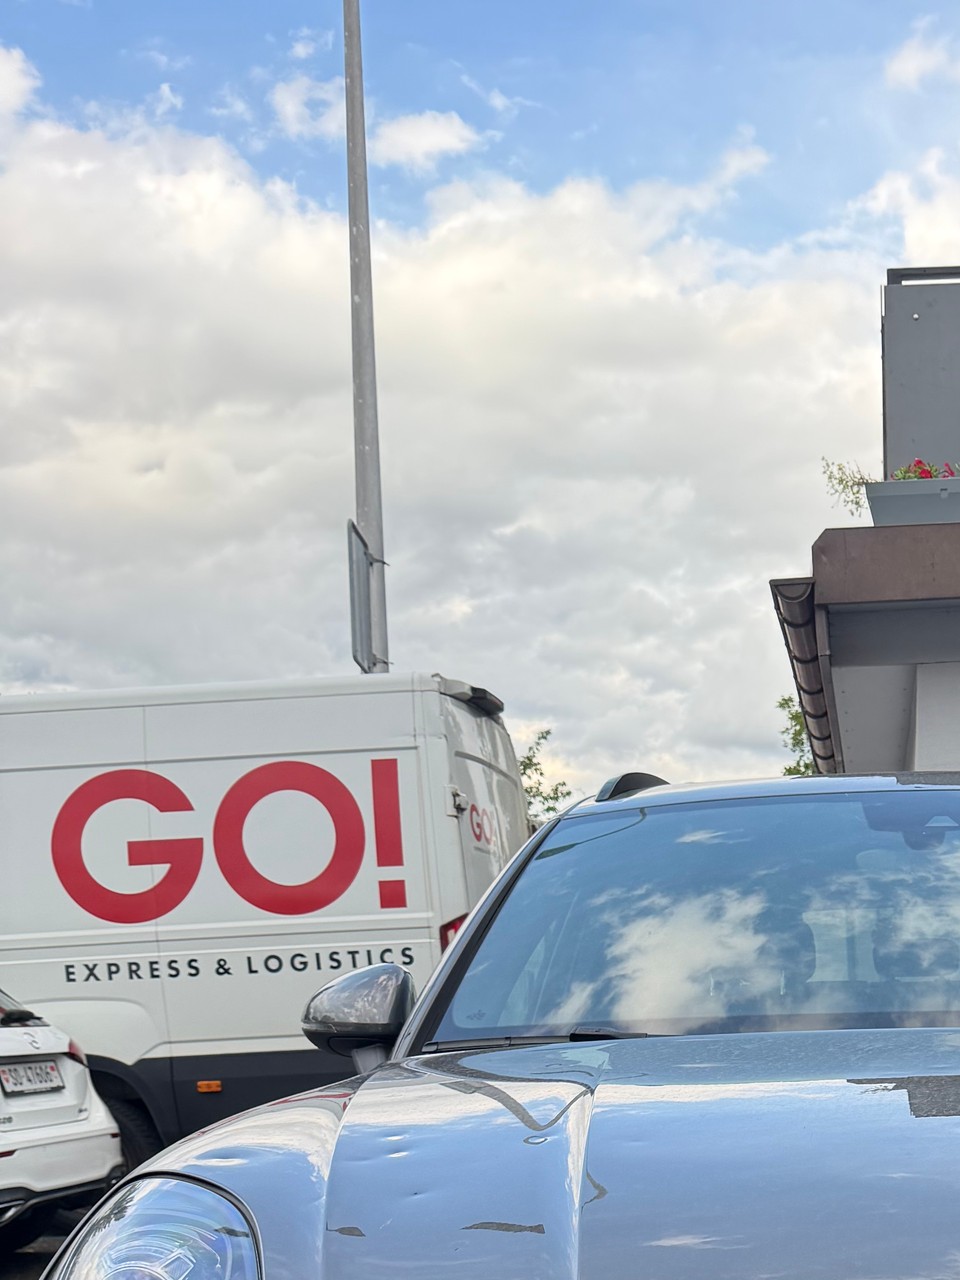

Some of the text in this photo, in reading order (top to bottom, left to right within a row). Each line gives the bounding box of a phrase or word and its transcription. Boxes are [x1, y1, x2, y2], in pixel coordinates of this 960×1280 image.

[51, 758, 407, 924] GO!
[64, 947, 414, 983] EXPRESS & LOGISTICS
